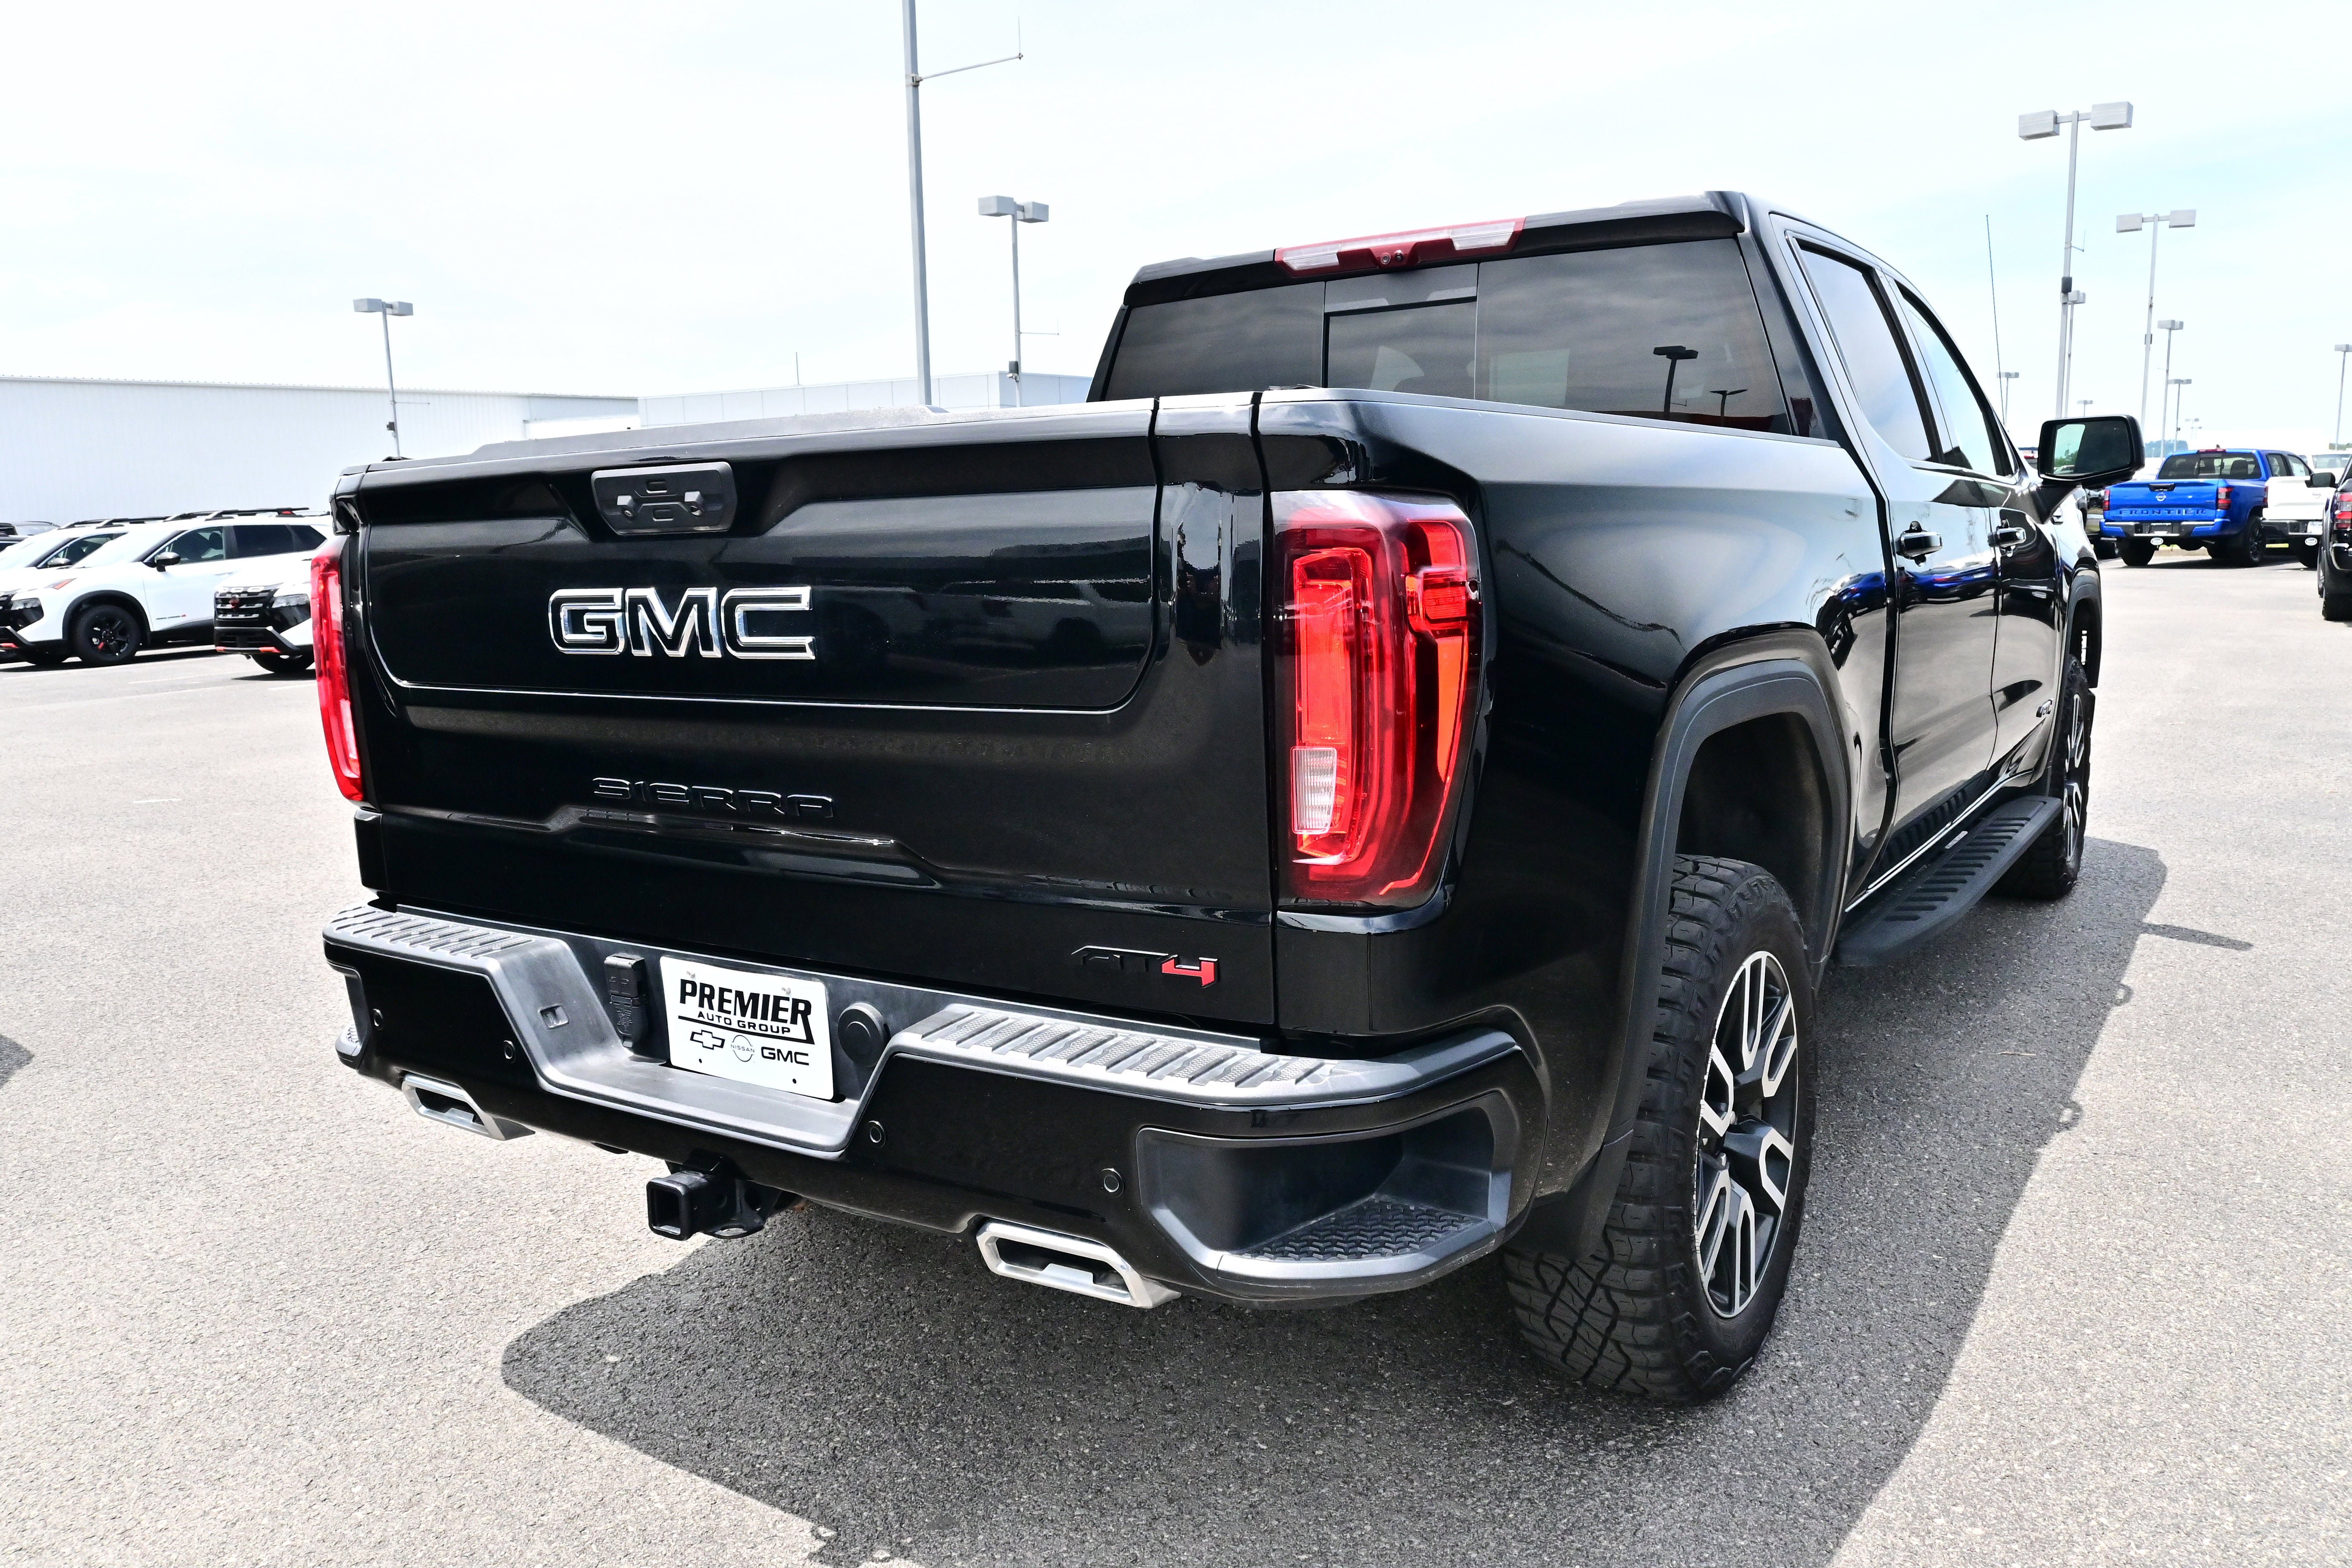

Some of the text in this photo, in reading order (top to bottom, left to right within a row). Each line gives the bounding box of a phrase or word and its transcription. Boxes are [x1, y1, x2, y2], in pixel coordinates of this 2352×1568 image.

[548, 586, 816, 659] GMC
[592, 777, 834, 818] SIERRA
[680, 979, 815, 1044] PREMIER
[698, 1011, 790, 1034] AUTO GROUP
[731, 1044, 754, 1053] NISSAN
[761, 1046, 809, 1066] GMC
